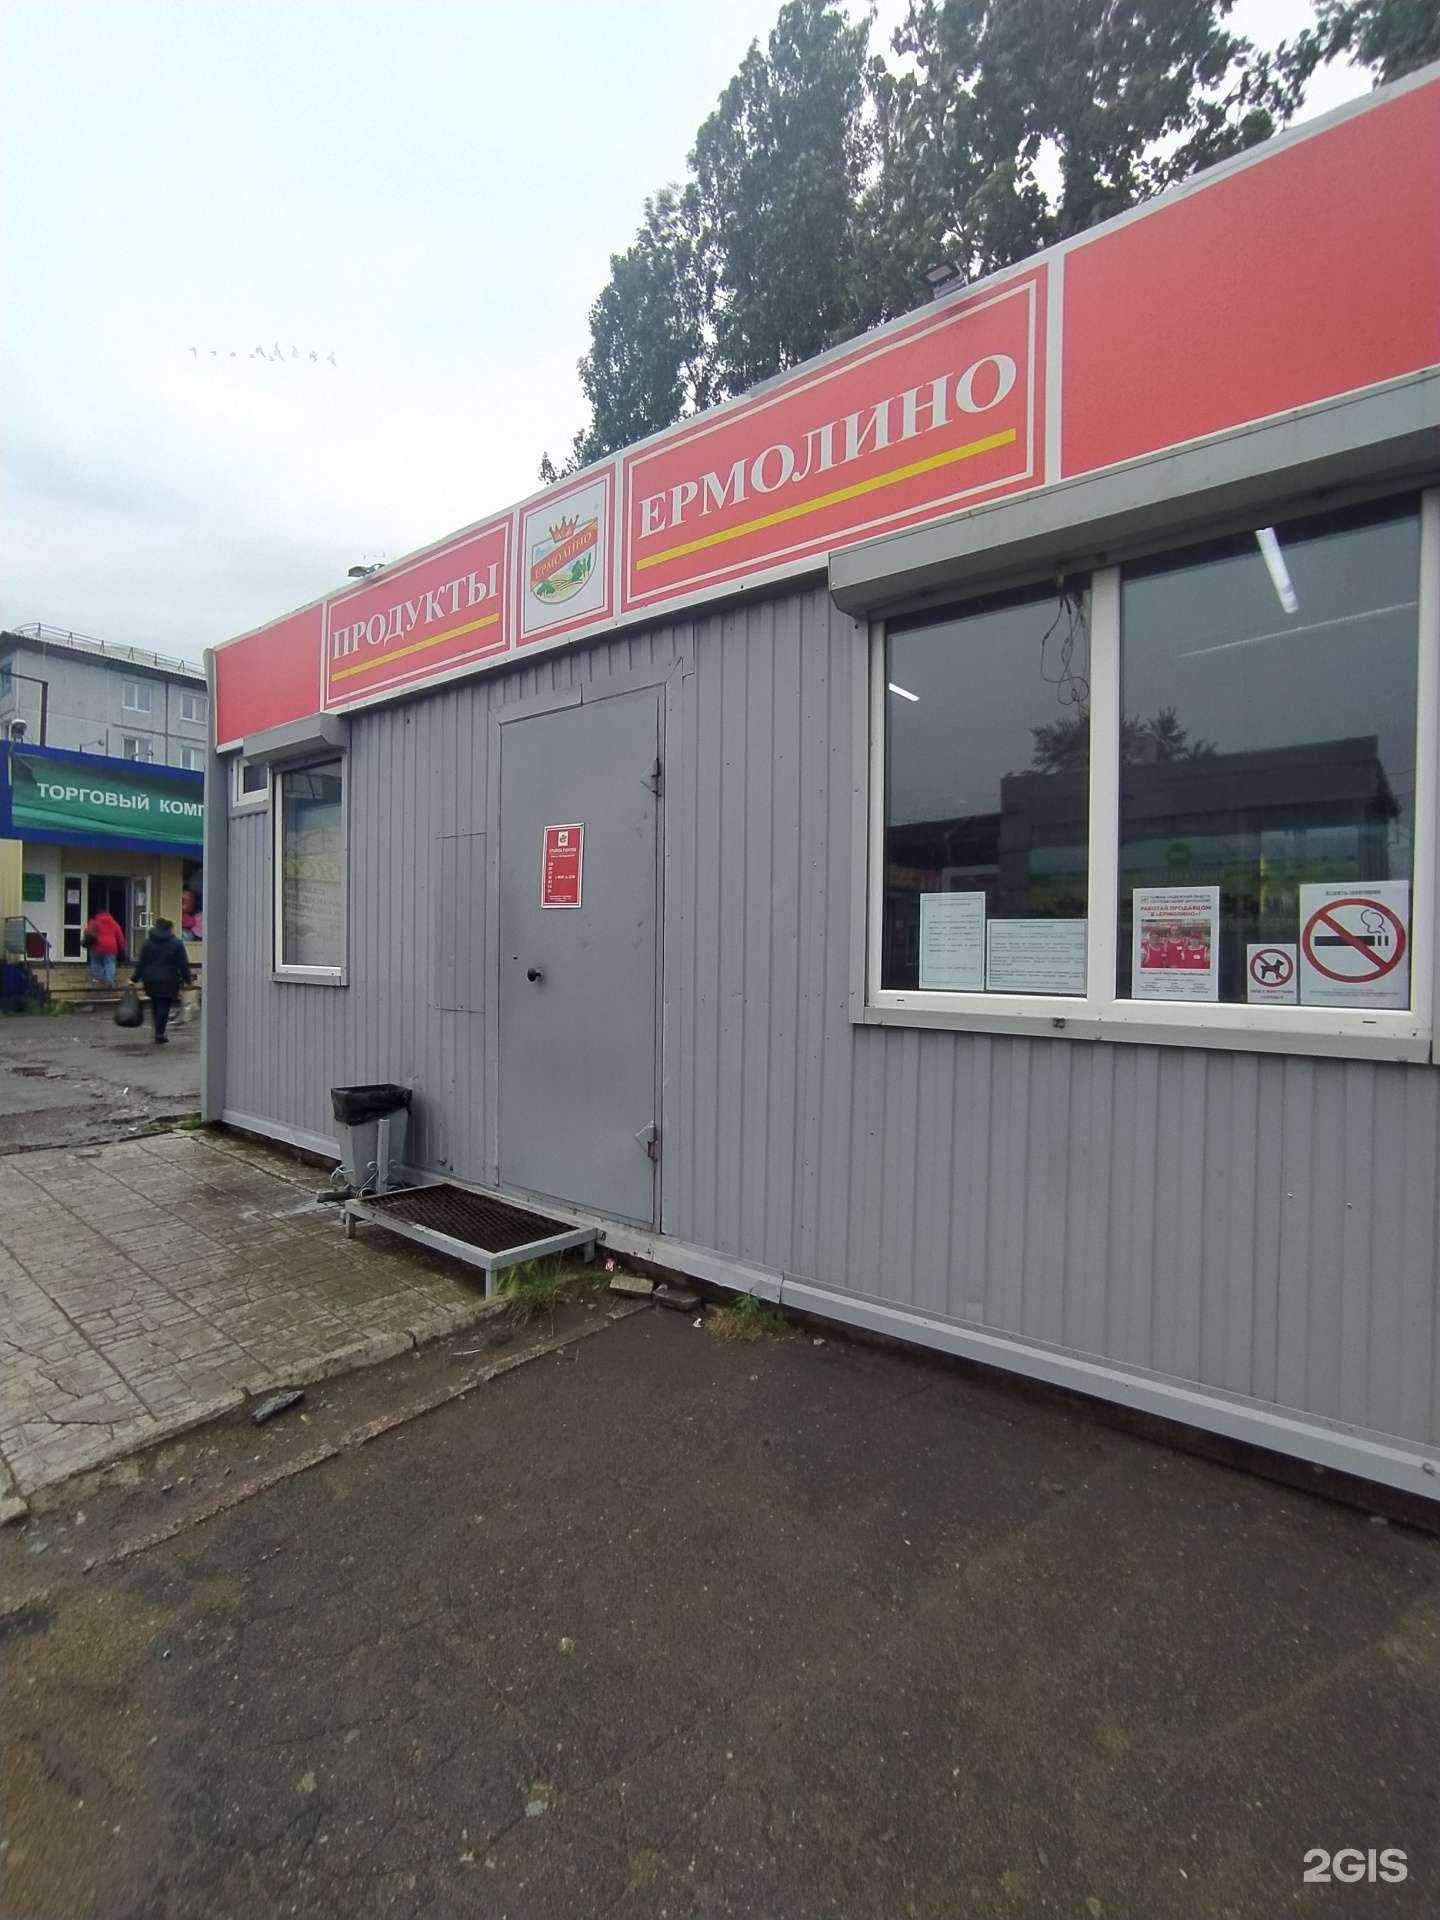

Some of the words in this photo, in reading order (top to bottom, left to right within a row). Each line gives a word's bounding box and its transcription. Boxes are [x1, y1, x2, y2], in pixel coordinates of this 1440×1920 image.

[637, 353, 1017, 539] ЕРМОЛИНО
[332, 562, 499, 660] ПРОДУКТЫ
[36, 782, 150, 811] ТОРГОВЫЙ
